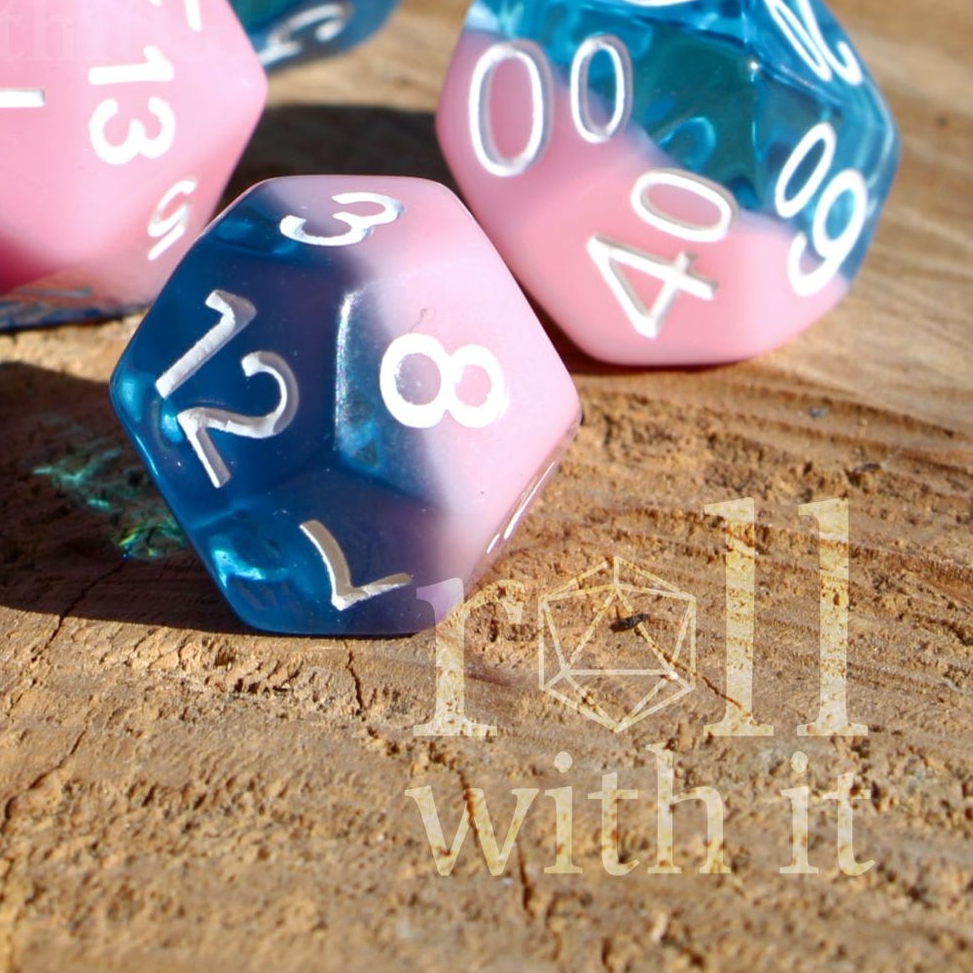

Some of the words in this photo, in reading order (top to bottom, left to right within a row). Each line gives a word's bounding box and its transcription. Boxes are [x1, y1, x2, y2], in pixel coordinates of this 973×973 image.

[87, 44, 176, 165] 13
[469, 33, 632, 177] 00
[147, 178, 198, 261] 5
[279, 191, 406, 247] 3
[585, 167, 739, 339] 40
[155, 289, 300, 489] 12
[379, 333, 511, 429] 8
[299, 519, 415, 612] 7
